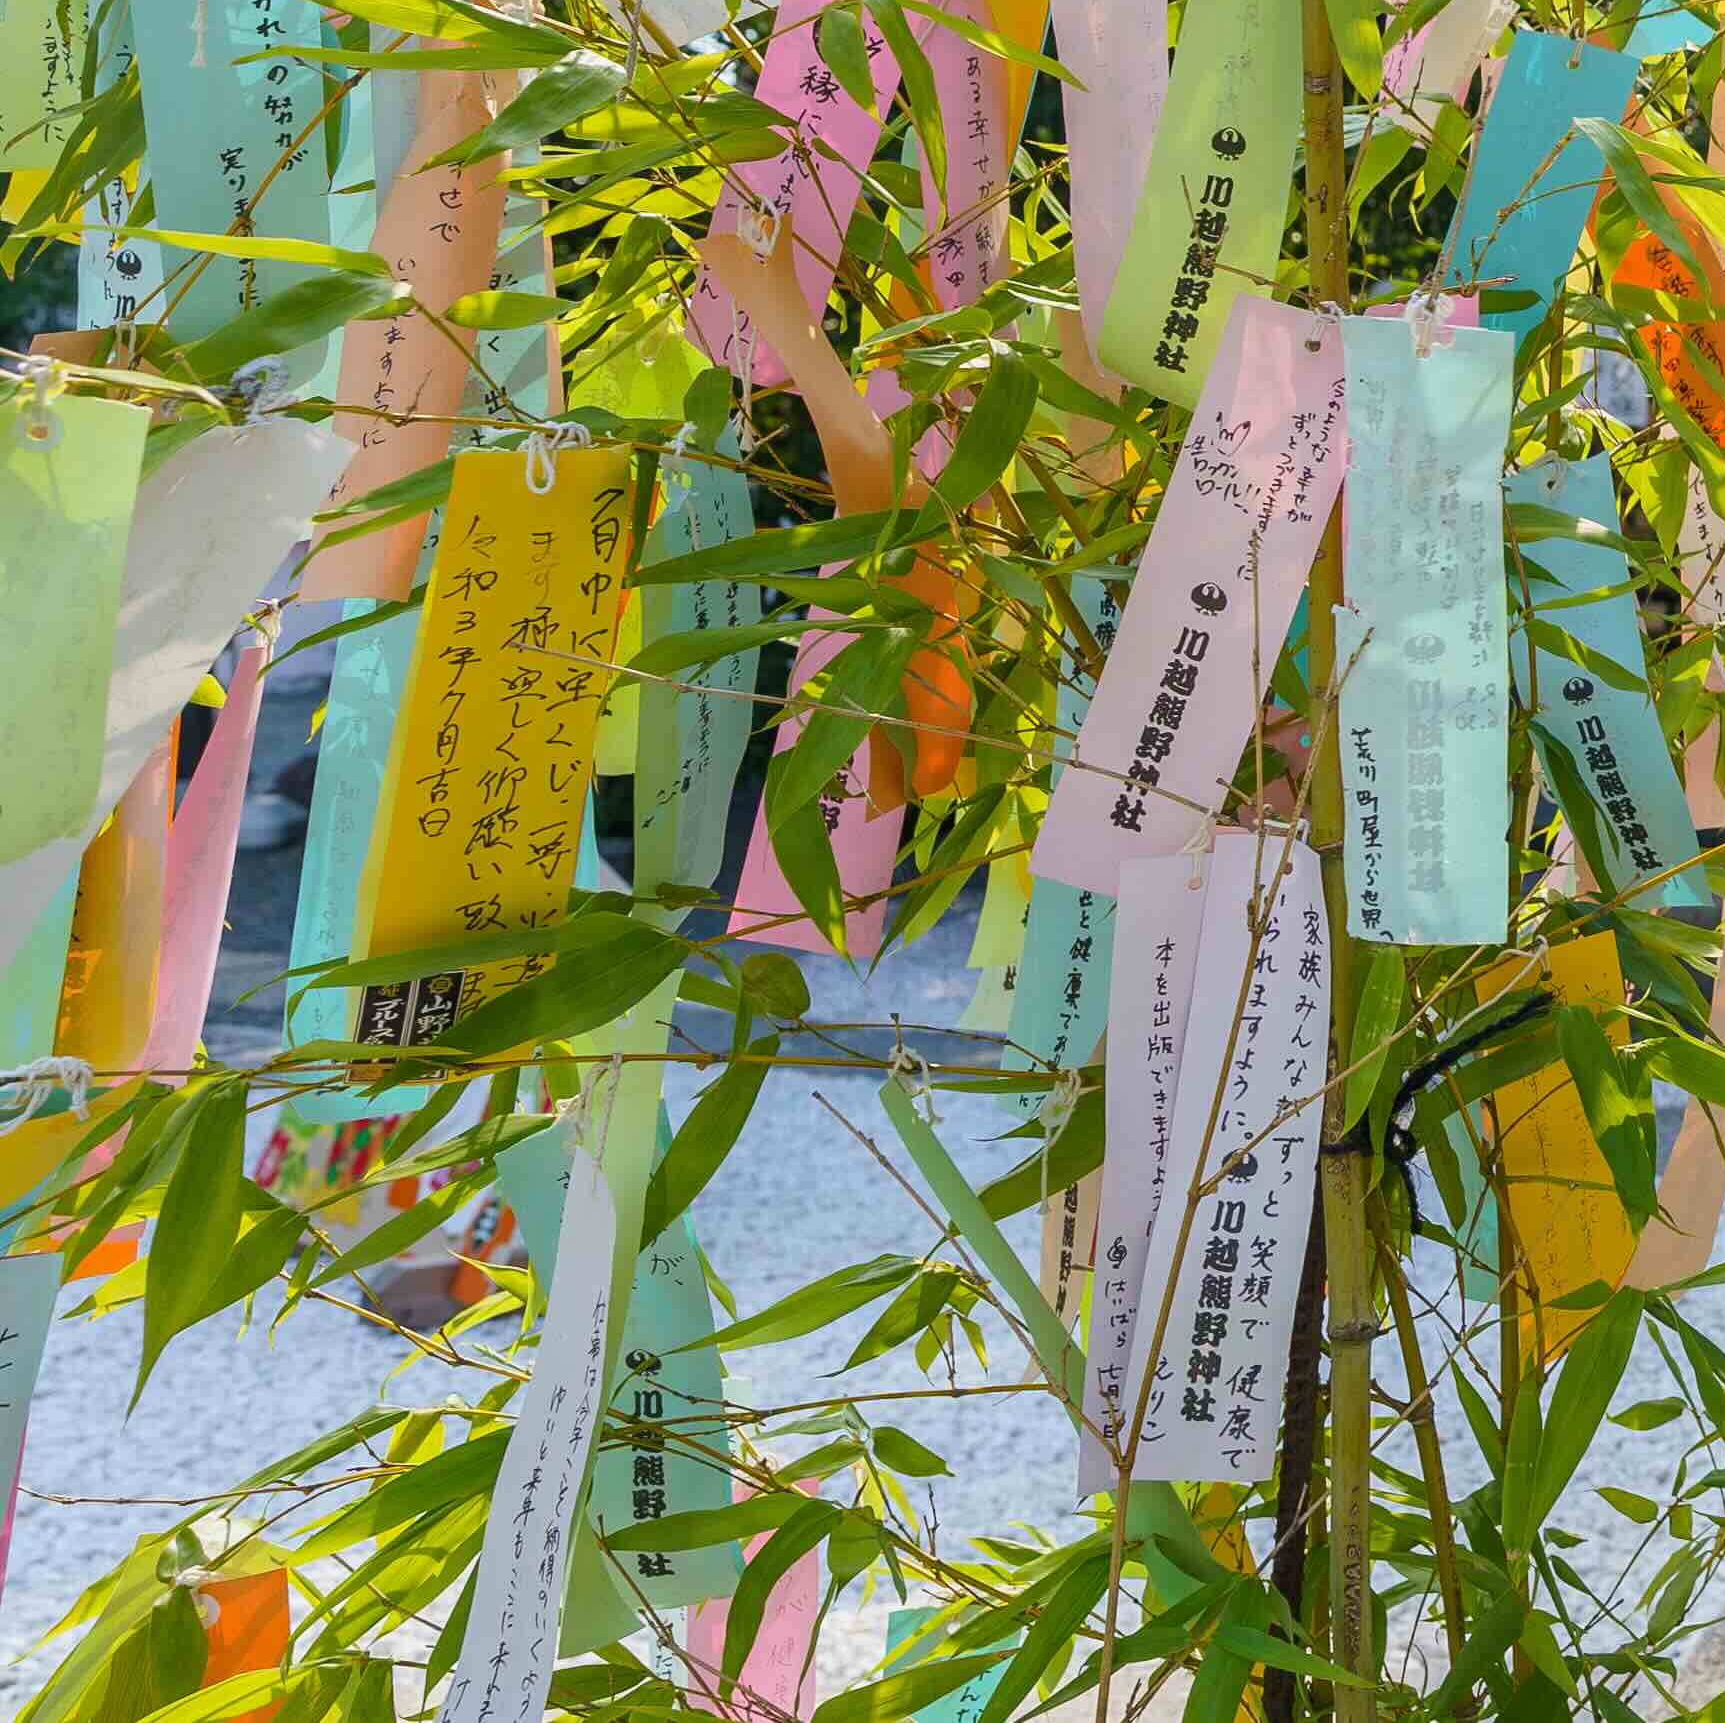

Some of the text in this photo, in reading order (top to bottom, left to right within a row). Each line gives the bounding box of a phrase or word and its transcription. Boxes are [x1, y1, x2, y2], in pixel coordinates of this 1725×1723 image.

[1153, 174, 1234, 373] 川越熊野神社
[1110, 627, 1209, 832] 川越熊野神社
[1575, 715, 1662, 874] 川越熊野神社
[1180, 1199, 1245, 1425] 川越熊野神社
